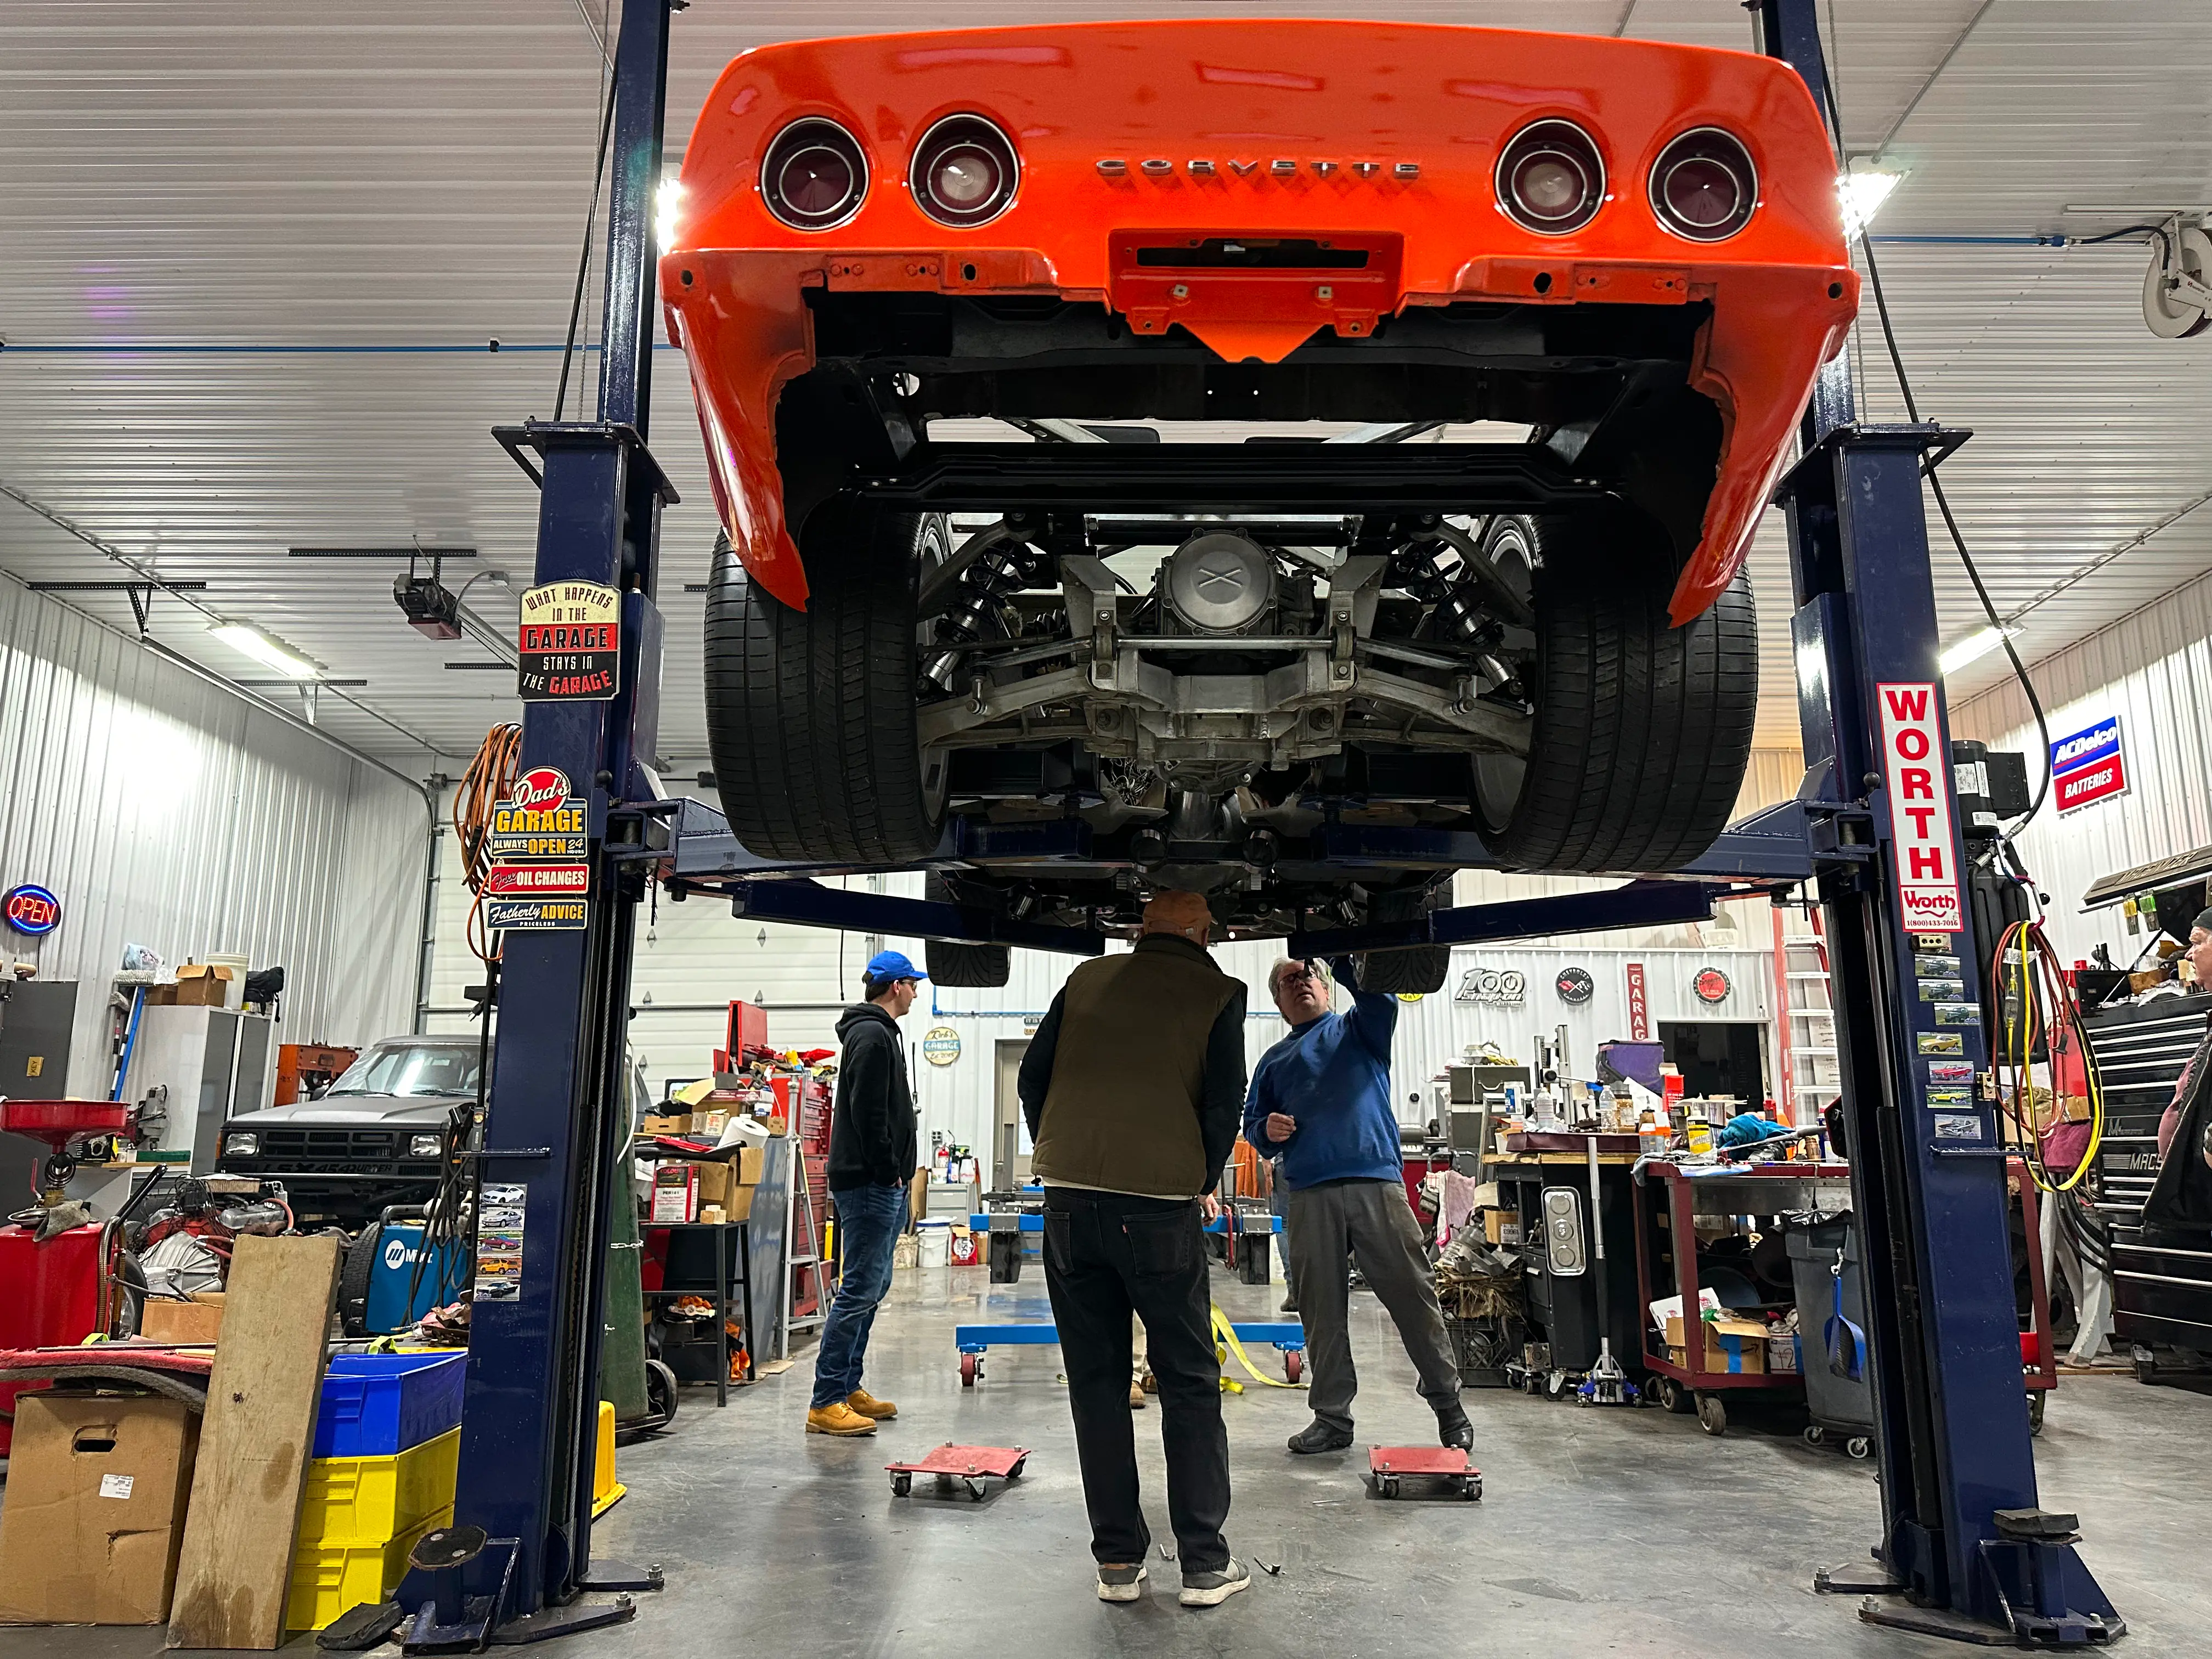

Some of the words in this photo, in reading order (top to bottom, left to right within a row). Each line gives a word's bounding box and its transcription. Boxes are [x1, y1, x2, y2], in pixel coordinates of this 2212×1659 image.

[1096, 159, 1419, 179] CORVETTE
[526, 589, 556, 610] WHAT
[565, 587, 613, 608] HAPPENS
[552, 608, 562, 621] IN
[569, 607, 586, 620] THE
[526, 627, 608, 650] GARAGE
[543, 656, 576, 670] STAYS
[582, 656, 592, 669] IN
[523, 673, 545, 690] THE
[549, 669, 612, 695] GARAGE
[2055, 726, 2117, 764] ACDelco
[511, 776, 571, 809] Dad's
[1885, 690, 1944, 879] WORTH
[2064, 768, 2113, 799] BATTERIES
[496, 809, 583, 832] GARAGE
[493, 839, 528, 849] ALWAYS
[528, 839, 566, 854] OPEN
[567, 839, 583, 849] 24
[492, 871, 516, 890] Free
[516, 871, 533, 885] OIL
[534, 871, 585, 885] CHANGES
[9, 896, 57, 923] OPEN
[1904, 891, 1955, 910] Worth
[490, 904, 541, 923] Fatherly
[541, 905, 583, 919] ADVICE
[1560, 968, 1589, 979] CHEVROLET
[1631, 974, 1646, 1040] GARAG
[925, 1041, 958, 1049] GARAGE
